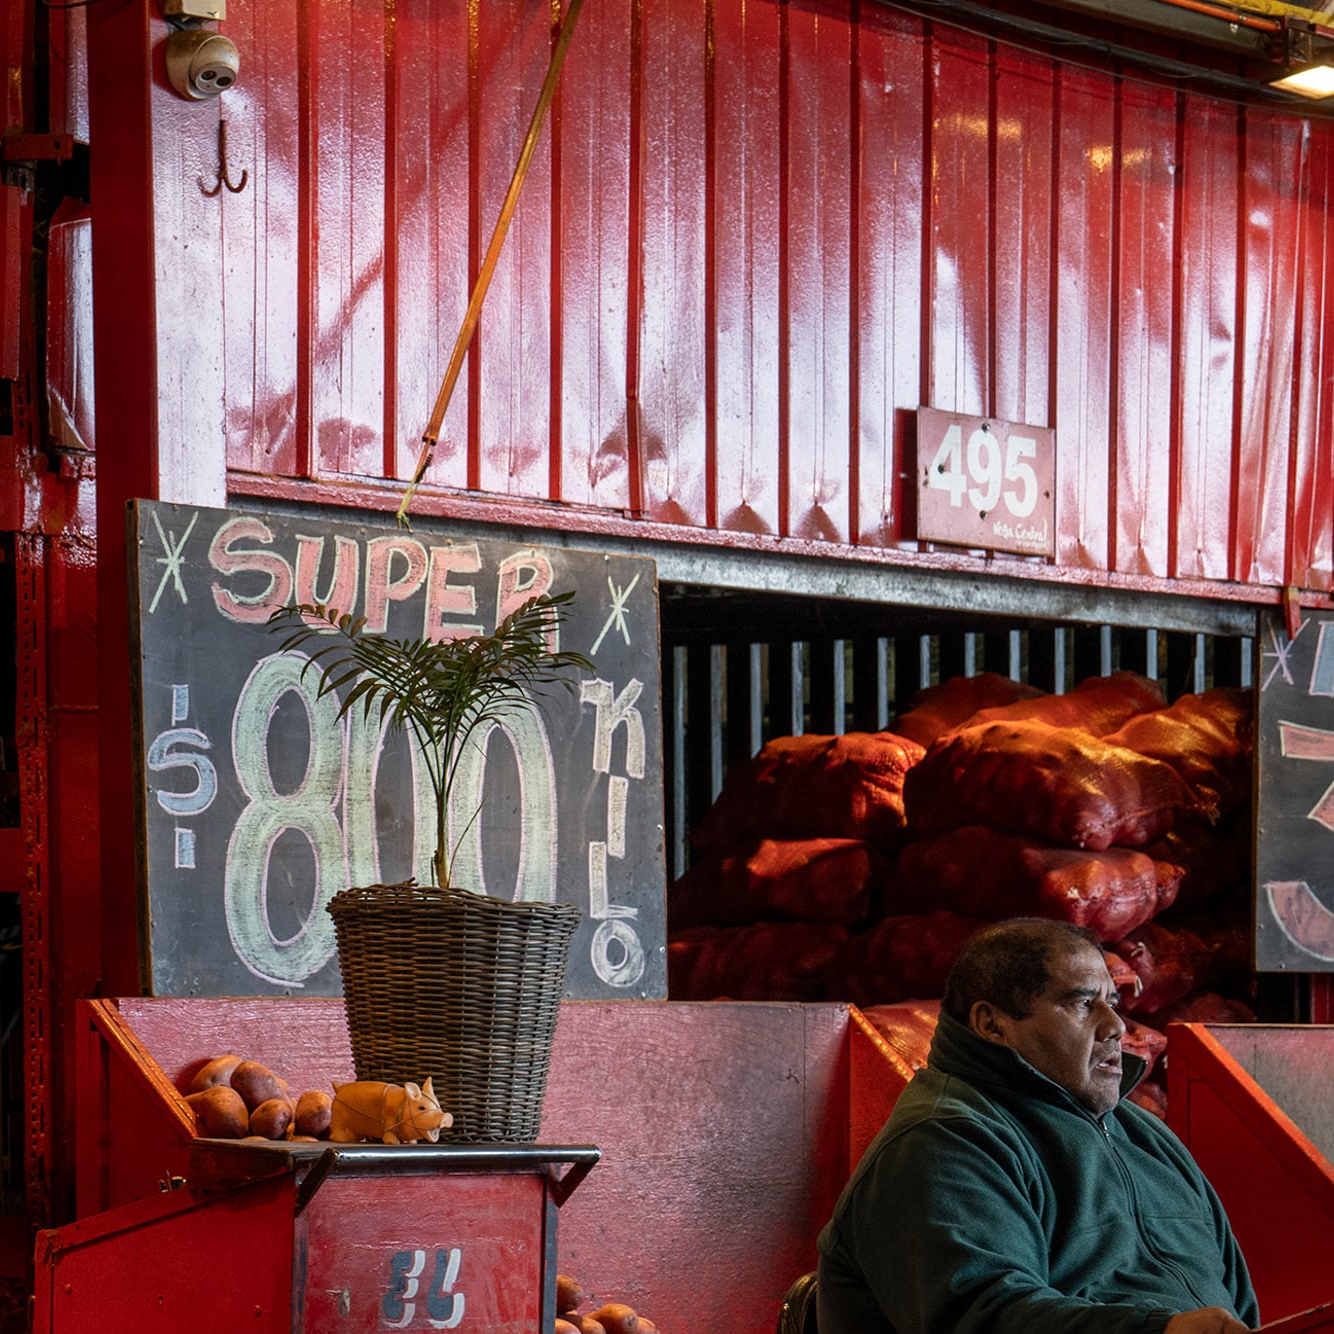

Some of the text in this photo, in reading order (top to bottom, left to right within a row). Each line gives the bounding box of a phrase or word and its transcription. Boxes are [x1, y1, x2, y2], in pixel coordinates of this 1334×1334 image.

[929, 424, 1038, 518] 495
[208, 516, 560, 653] SUPER
[1015, 516, 1048, 542] Central
[223, 649, 558, 988] 800
[581, 677, 646, 988] KILO
[382, 1247, 465, 1330] EL
